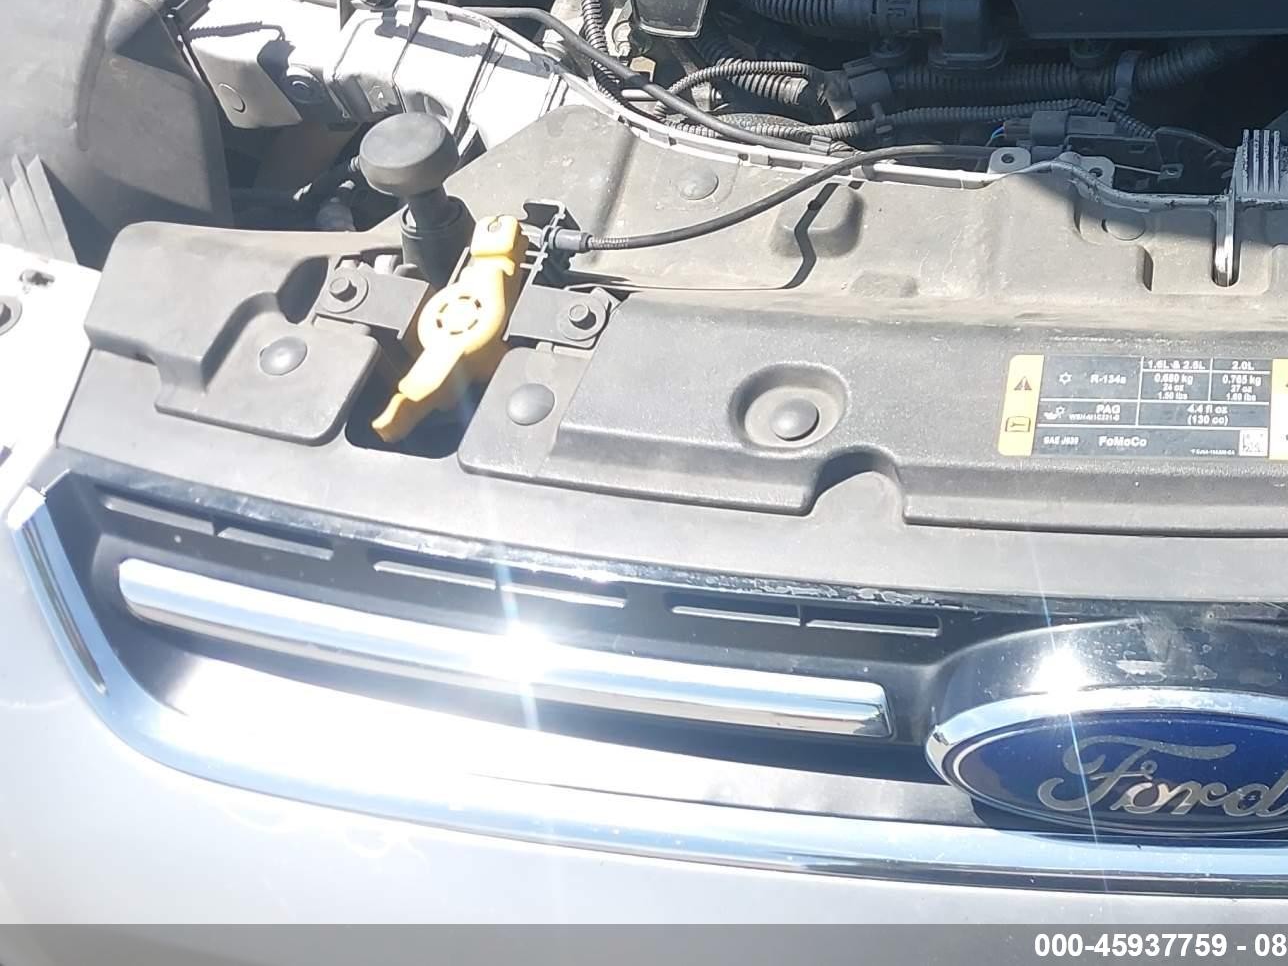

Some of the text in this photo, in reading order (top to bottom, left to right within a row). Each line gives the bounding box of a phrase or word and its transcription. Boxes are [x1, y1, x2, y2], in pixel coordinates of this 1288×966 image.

[1231, 361, 1255, 370] 2.0L
[1181, 373, 1194, 385] kg
[1249, 375, 1262, 387] kg
[1096, 404, 1121, 414] PAG
[1187, 404, 1204, 414] 4.4
[1214, 405, 1228, 414] oz
[1187, 415, 1210, 426] (130
[1098, 436, 1148, 447] FoMoCo
